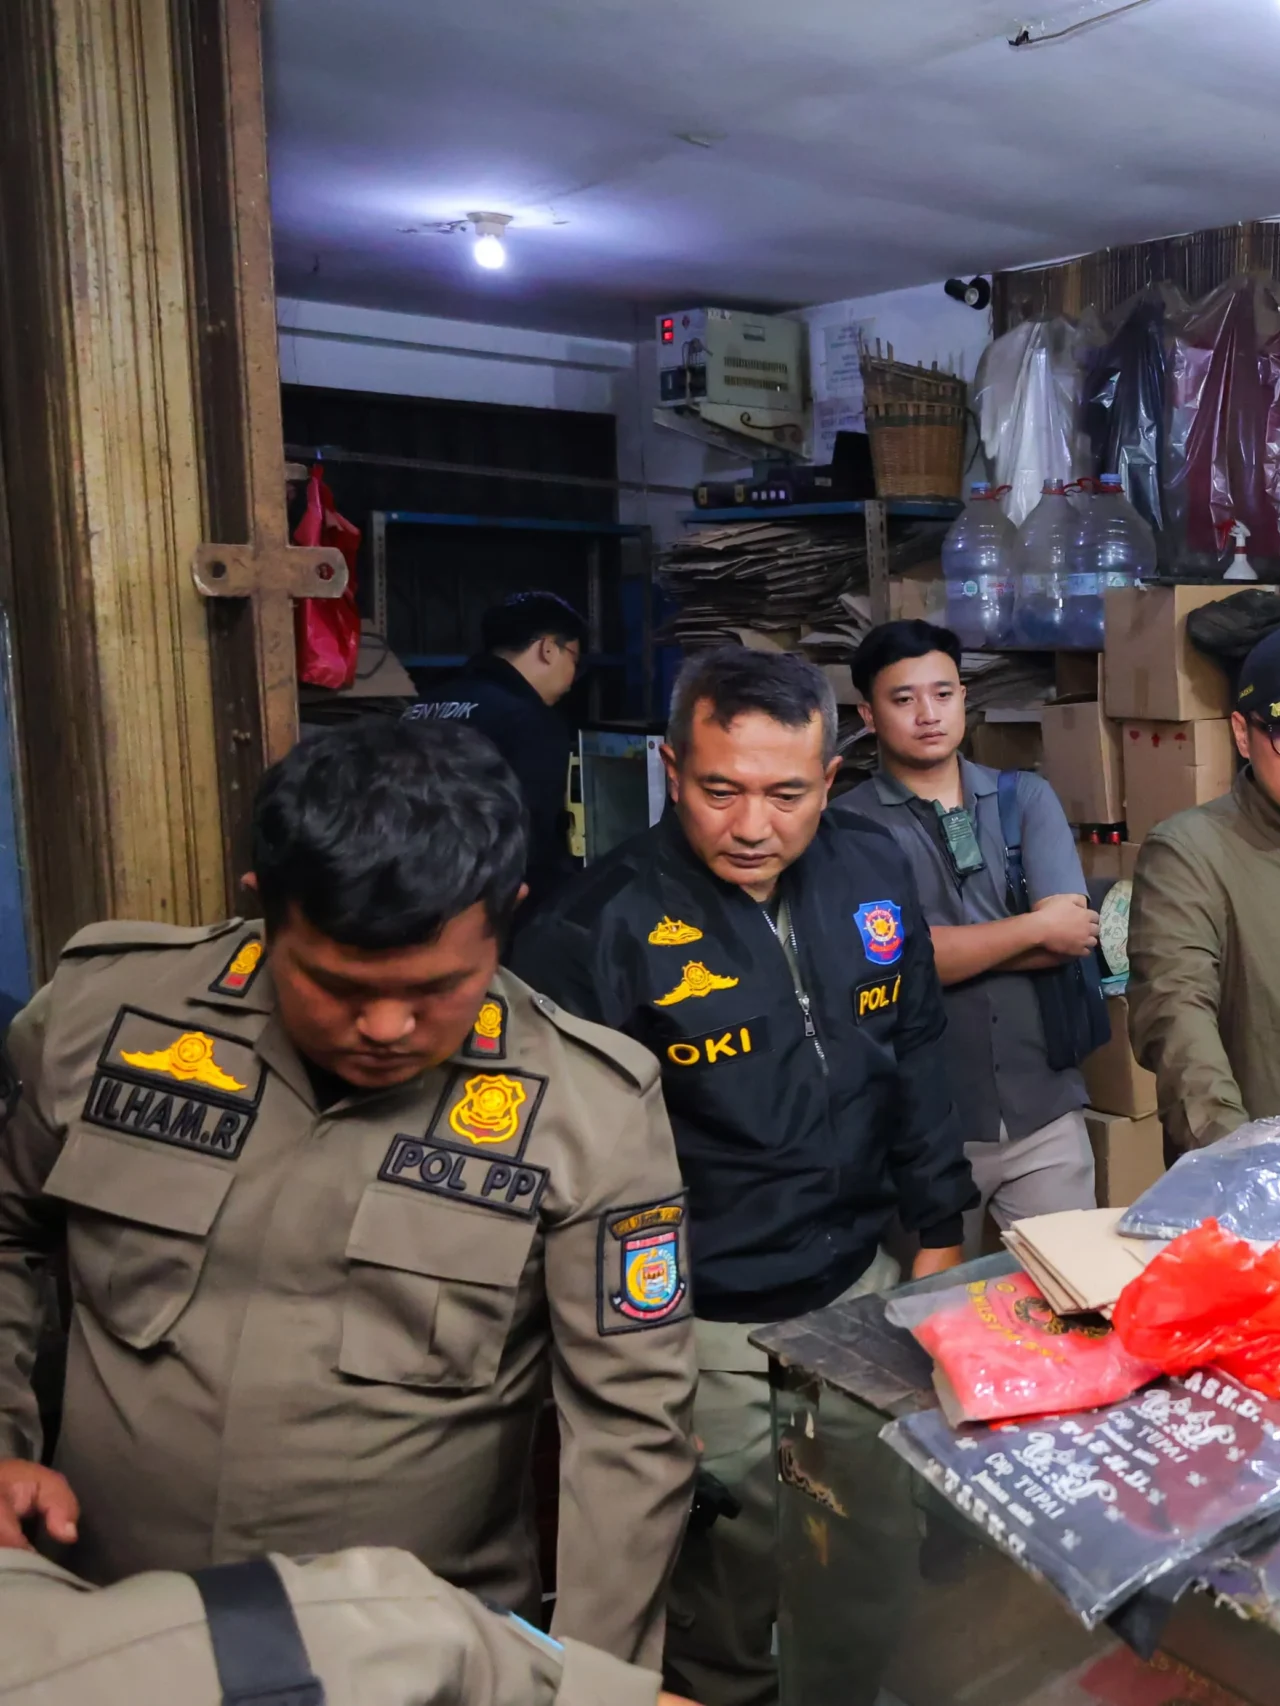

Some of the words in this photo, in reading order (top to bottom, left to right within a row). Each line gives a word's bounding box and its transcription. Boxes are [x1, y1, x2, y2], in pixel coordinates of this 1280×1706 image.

[859, 985, 890, 1016] POL
[667, 1027, 752, 1066] OKI
[93, 1078, 241, 1150] ILHAM.R
[391, 1142, 467, 1191] POL
[480, 1162, 536, 1203] PP
[1013, 1474, 1066, 1520] TUPAI
